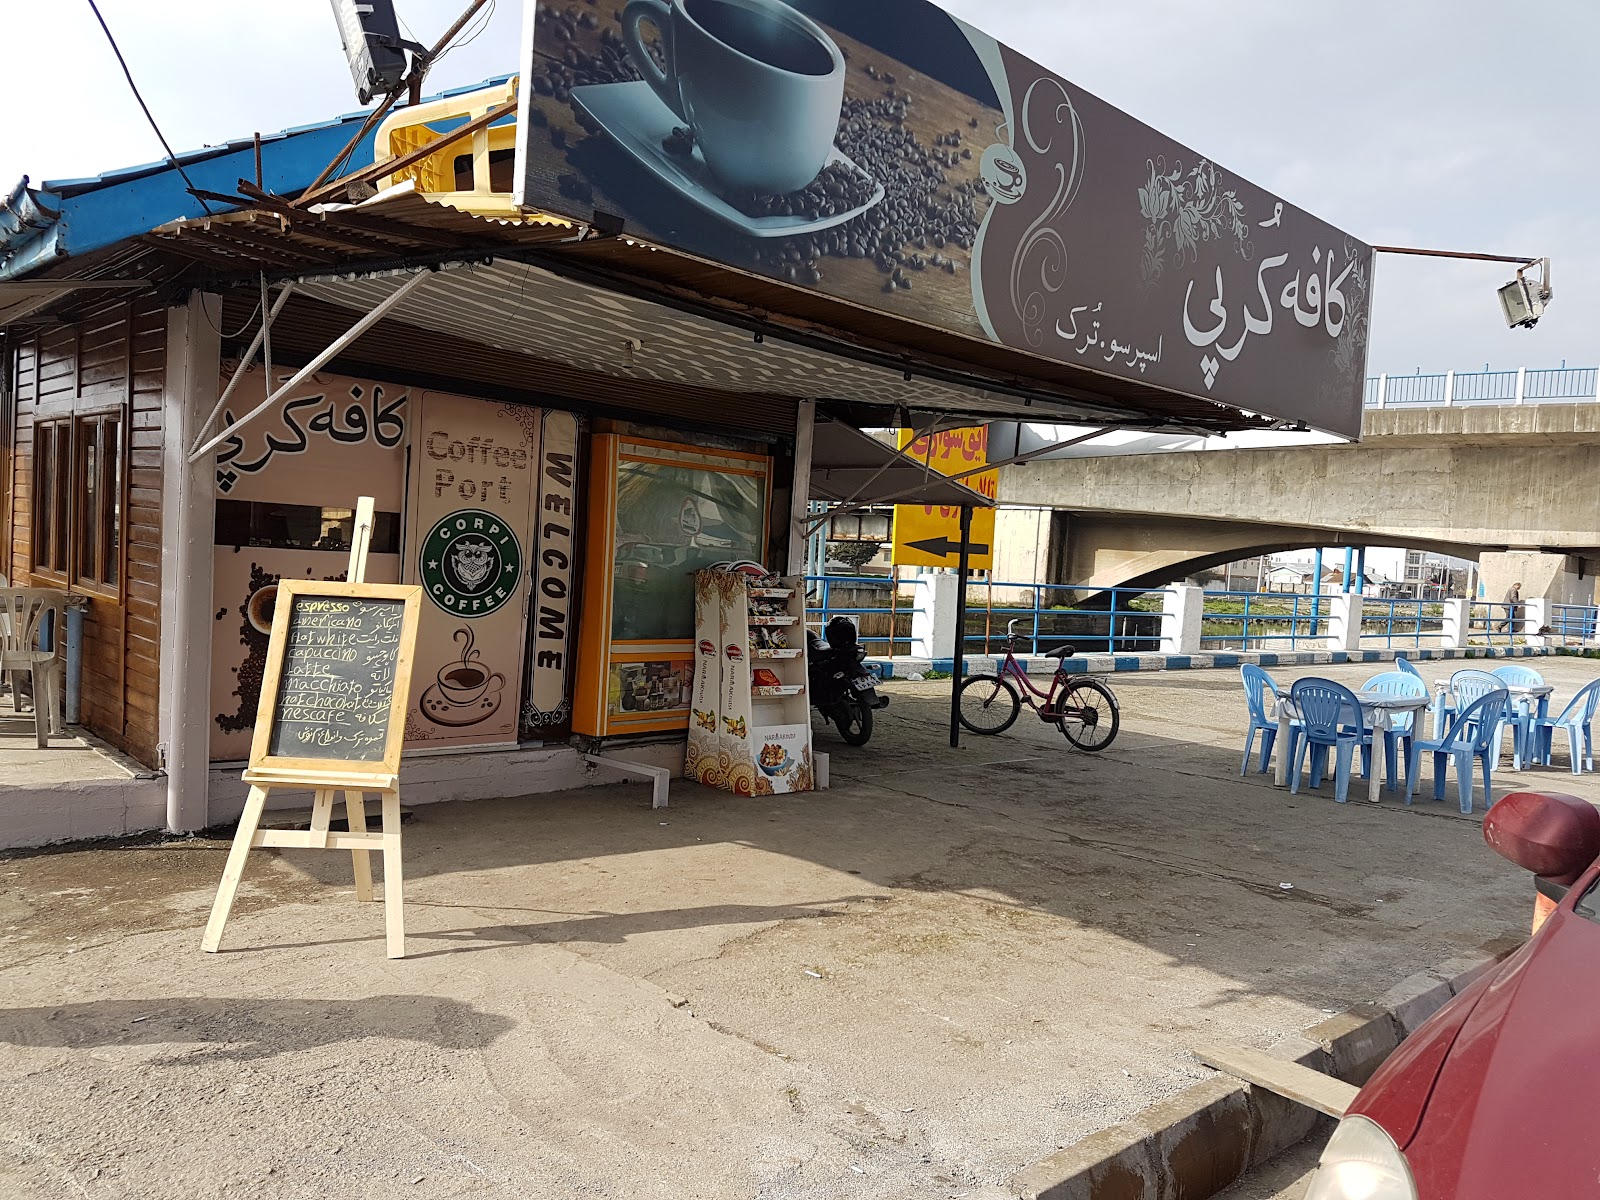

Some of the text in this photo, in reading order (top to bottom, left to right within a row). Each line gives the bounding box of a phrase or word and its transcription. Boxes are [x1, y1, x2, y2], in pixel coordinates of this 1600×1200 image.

[1280, 245, 1356, 338] کافه
[308, 384, 407, 450] کافه
[426, 430, 527, 470] Coffee
[439, 517, 510, 545] CORPI
[537, 452, 573, 671] WELCOME
[296, 600, 350, 614] espresso
[432, 583, 507, 611] COFFEE
[293, 614, 362, 628] americano
[282, 707, 345, 724] nescafe
